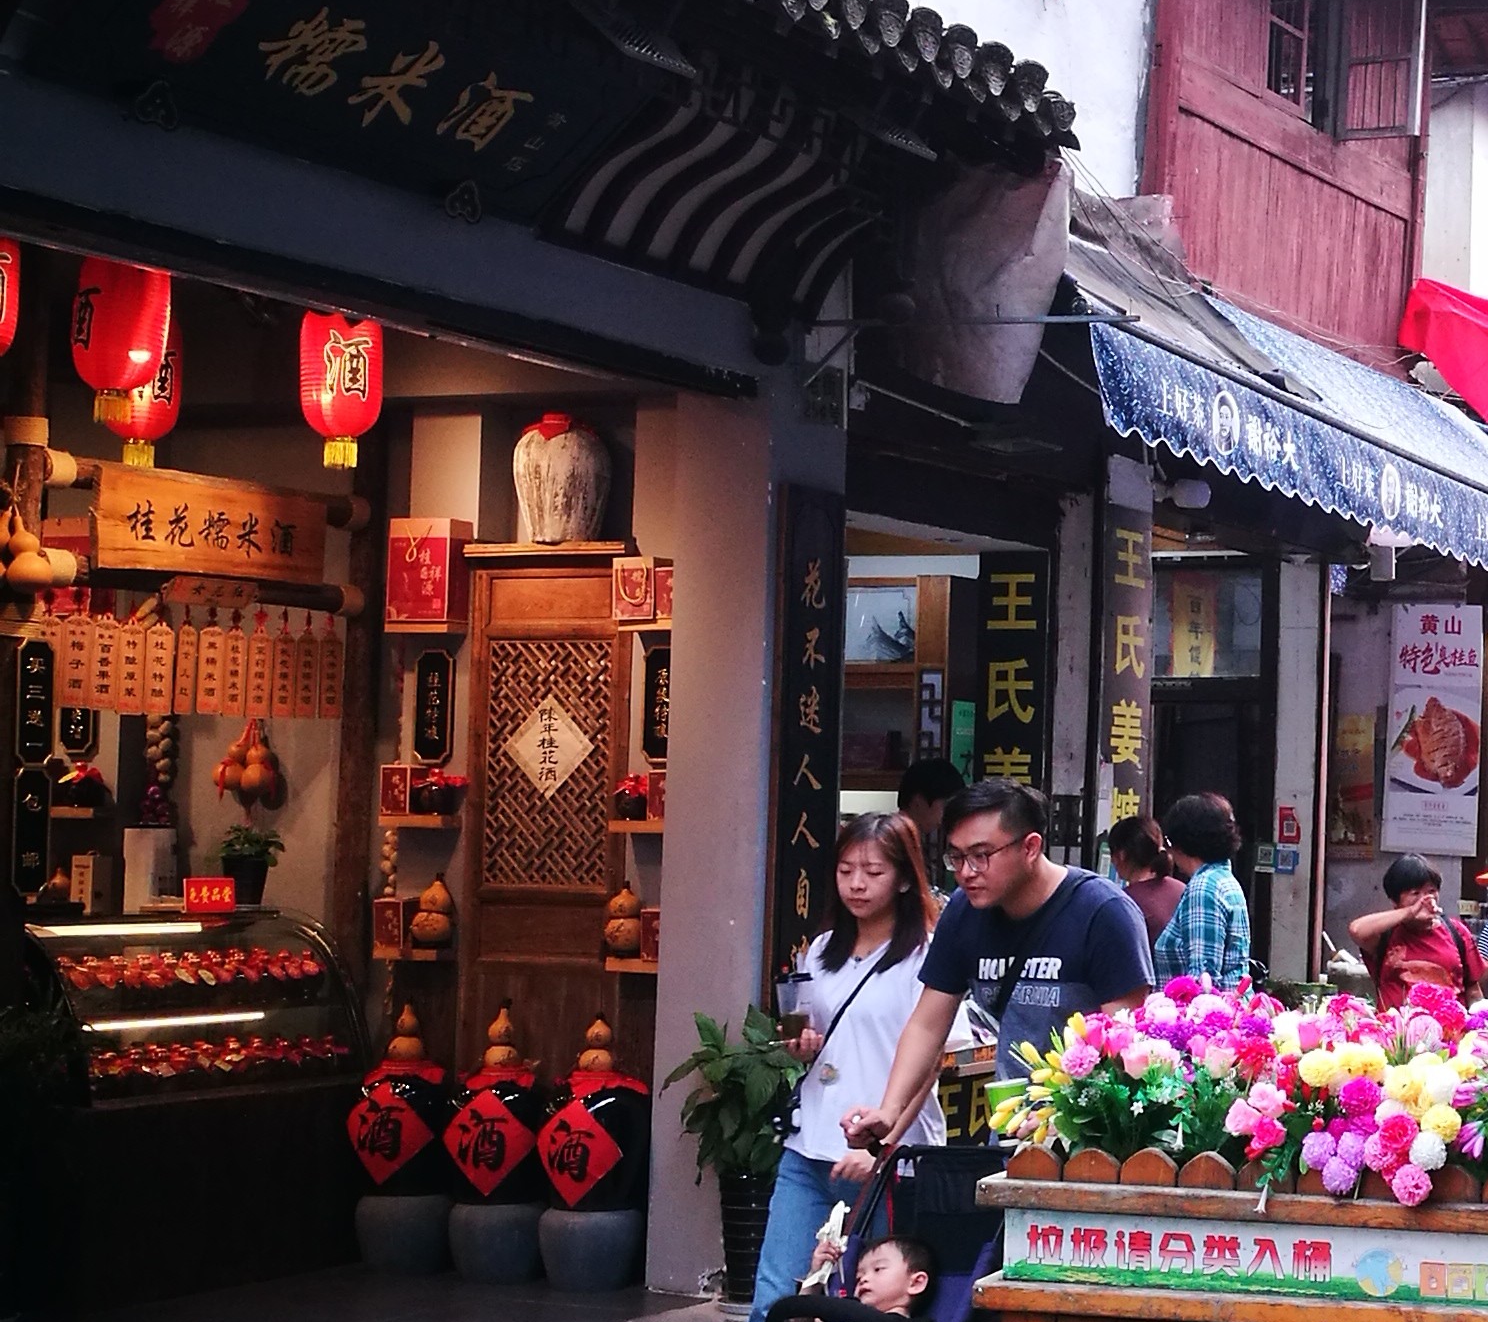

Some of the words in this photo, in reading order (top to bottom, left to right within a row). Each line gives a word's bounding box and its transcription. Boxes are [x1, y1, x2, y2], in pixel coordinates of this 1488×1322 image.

[259, 5, 535, 153] 糯米酒
[323, 329, 373, 402] 酒
[126, 499, 297, 559] 桂花糯米酒
[1420, 614, 1462, 635] 黄山
[67, 640, 86, 690] 梅子酒
[95, 644, 114, 695] 百香果酒
[26, 656, 46, 747] 买三送一
[357, 1097, 405, 1161] 酒
[458, 1107, 508, 1172] 酒
[549, 1118, 596, 1183] 酒
[1026, 1223, 1333, 1283] 垃圾请分类入桶
